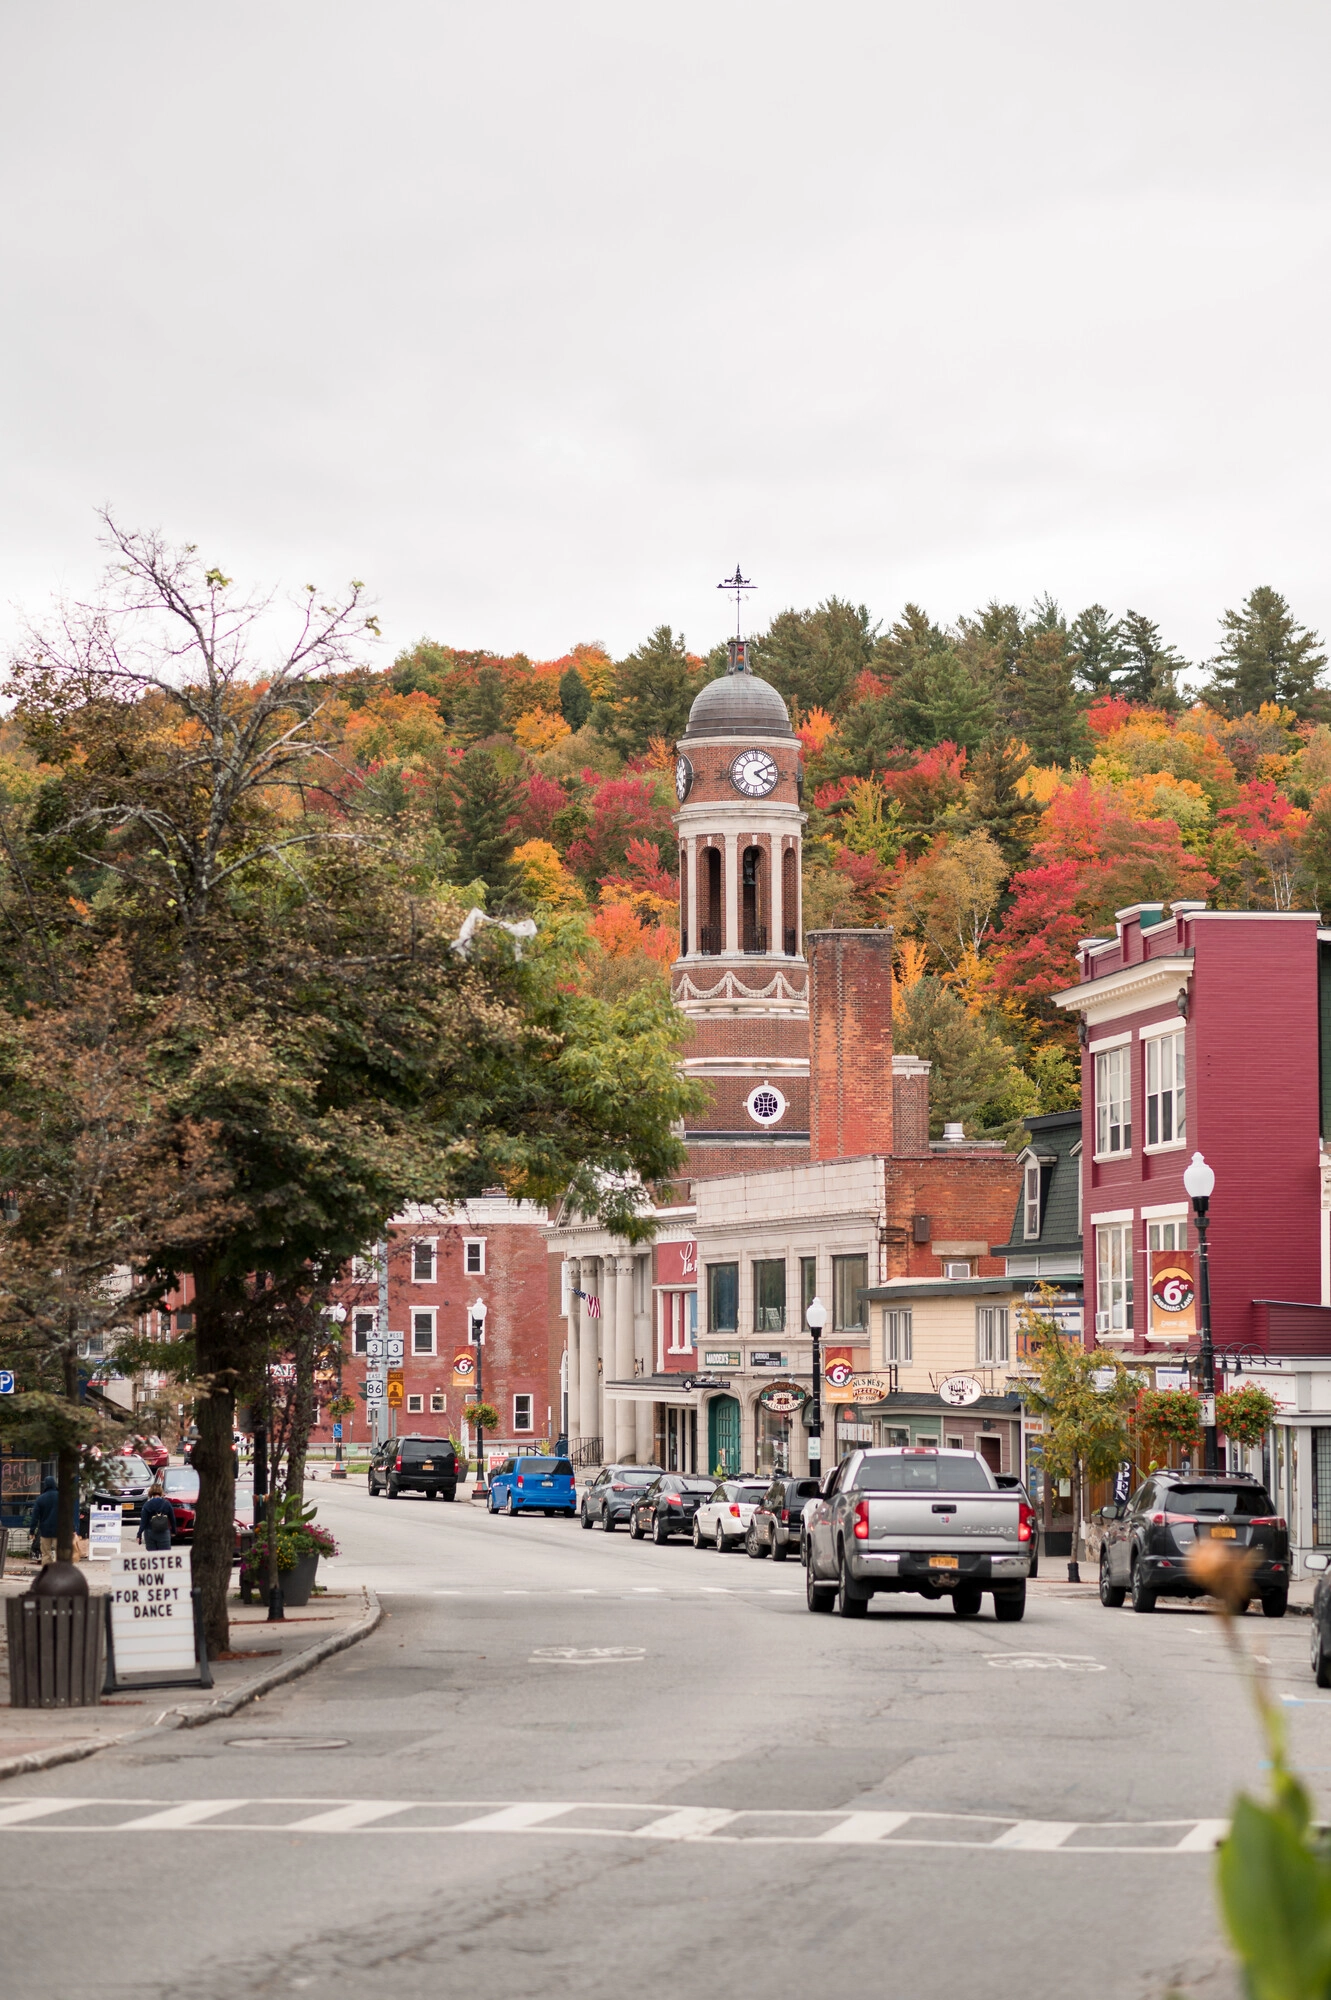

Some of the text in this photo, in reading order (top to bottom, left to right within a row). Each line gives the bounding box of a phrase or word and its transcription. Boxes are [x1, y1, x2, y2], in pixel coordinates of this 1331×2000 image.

[1153, 1293, 1194, 1312] SARANAC LAKE
[372, 1343, 378, 1353] 3
[392, 1343, 399, 1353] 3
[368, 1384, 381, 1394] 86
[867, 1379, 885, 1389] NEST
[770, 1402, 797, 1410] LIQUOR
[1, 1462, 25, 1478] Art
[1115, 1461, 1131, 1501] OPEN
[963, 1525, 1016, 1534] TUNDRA
[123, 1556, 183, 1571] REGISTER
[138, 1573, 164, 1586] NOW
[116, 1588, 179, 1603] FOR SEPT
[134, 1604, 173, 1618] DANCE
